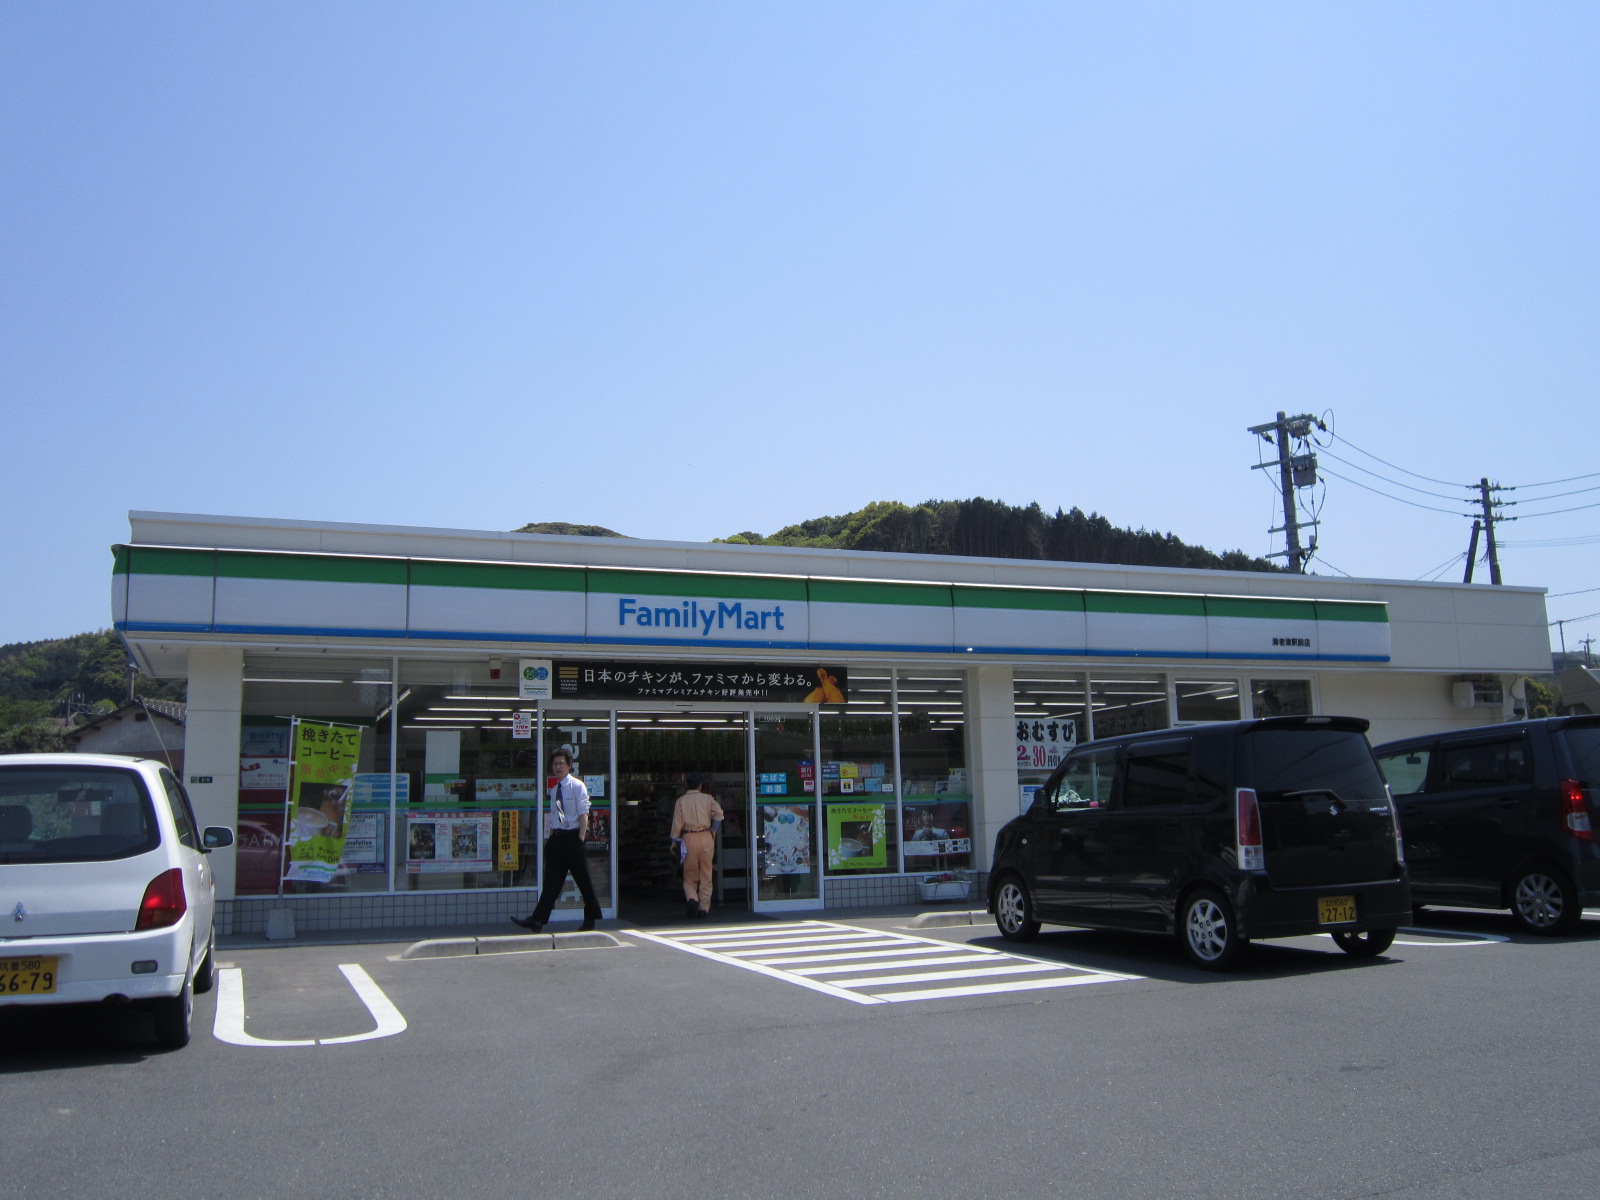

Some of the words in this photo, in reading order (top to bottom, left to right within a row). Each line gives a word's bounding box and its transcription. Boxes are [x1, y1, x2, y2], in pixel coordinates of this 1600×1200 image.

[619, 598, 784, 636] FamilyMart
[584, 668, 812, 687] 日本のチキンが、ファミマから変わる。
[302, 727, 357, 746] 挽きたて
[1016, 720, 1075, 742] おむすび
[302, 747, 356, 760] コーヒー
[761, 773, 785, 782] たばこ
[501, 811, 511, 851] 特別警戒中
[1326, 907, 1355, 921] 27-12
